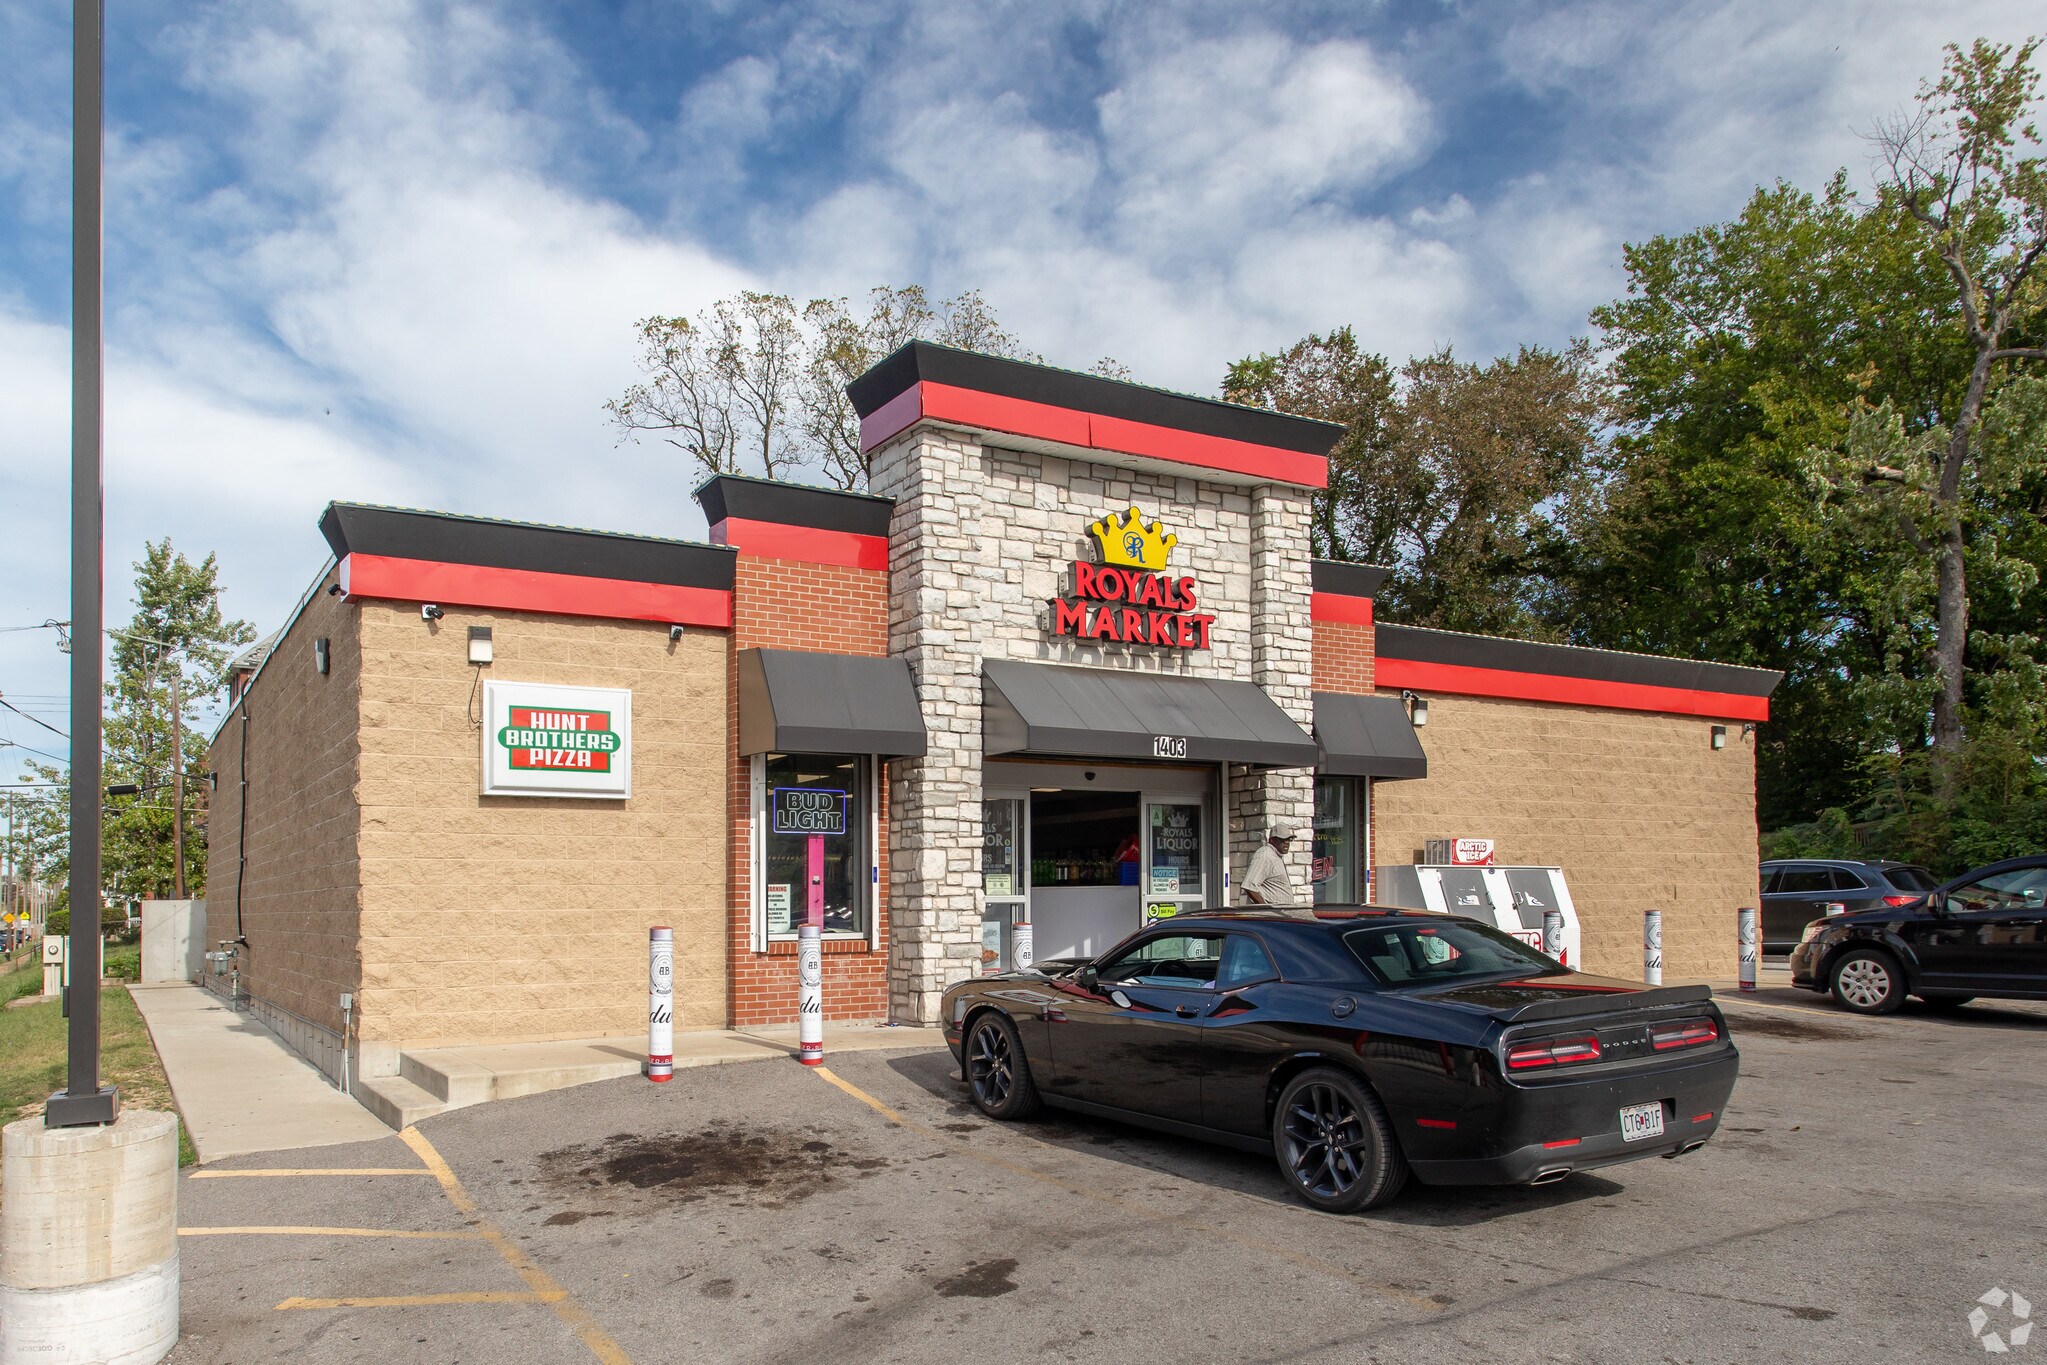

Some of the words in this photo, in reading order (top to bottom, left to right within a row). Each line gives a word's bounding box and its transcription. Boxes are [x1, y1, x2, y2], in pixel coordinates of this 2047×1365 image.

[1073, 560, 1197, 612] ROYALS
[1052, 597, 1216, 650] MARKET
[530, 711, 590, 732] HUNT
[505, 729, 614, 750] BROTHERS
[1154, 737, 1186, 758] 1403
[529, 748, 592, 768] PIZZA
[786, 791, 834, 812] BUD
[776, 809, 842, 830] LIGHT
[1163, 828, 1193, 838] ROYALS
[1156, 836, 1199, 851] LIQUOR
[1459, 841, 1487, 852] ARCTIC
[1168, 855, 1190, 864] HOURS
[1466, 851, 1481, 861] ICE
[1153, 869, 1177, 877] NOTICE
[1312, 856, 1334, 880] EN
[1603, 1038, 1646, 1048] DODGE
